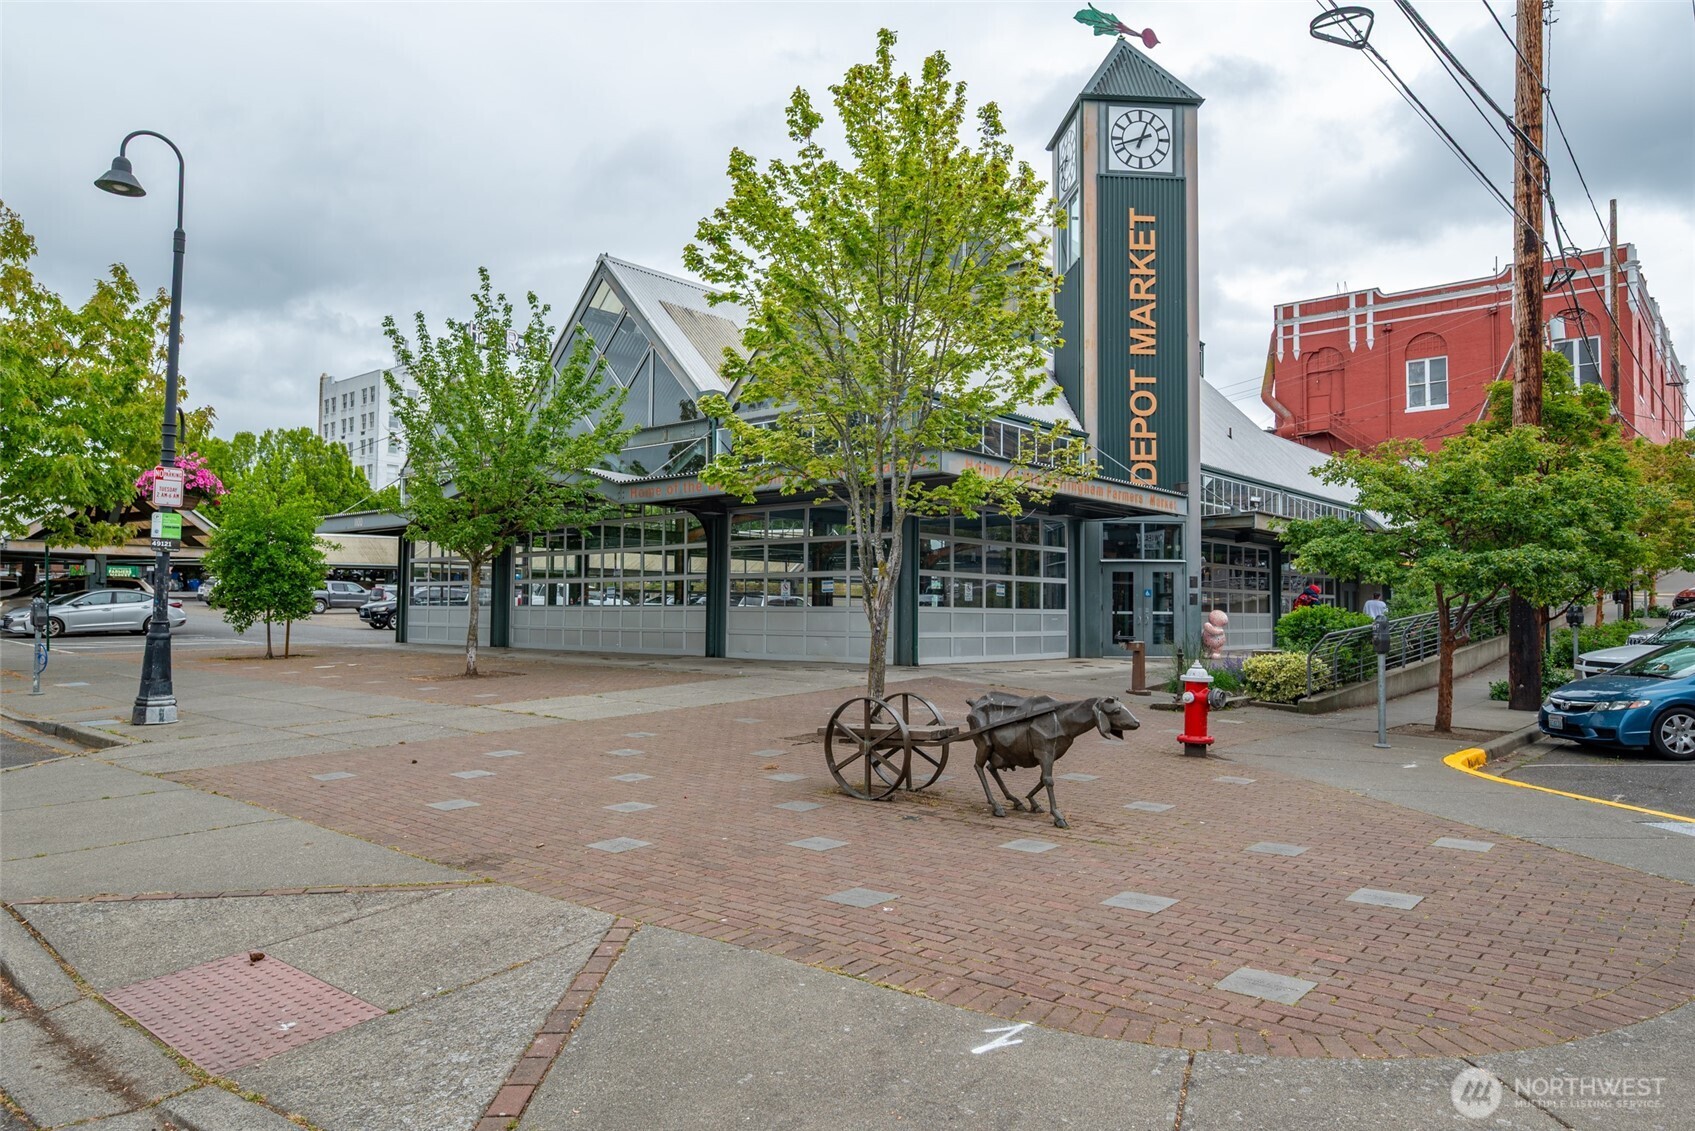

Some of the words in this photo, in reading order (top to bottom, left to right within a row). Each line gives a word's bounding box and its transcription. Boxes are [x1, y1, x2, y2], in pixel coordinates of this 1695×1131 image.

[1129, 207, 1156, 355] MARKET
[1129, 368, 1157, 486] DEPOT
[155, 469, 163, 478] NO
[164, 471, 182, 479] PARKING
[630, 485, 661, 499] Home
[666, 481, 679, 495] of
[683, 480, 702, 494] the
[1107, 485, 1143, 505] Farmers
[1149, 494, 1177, 512] Market
